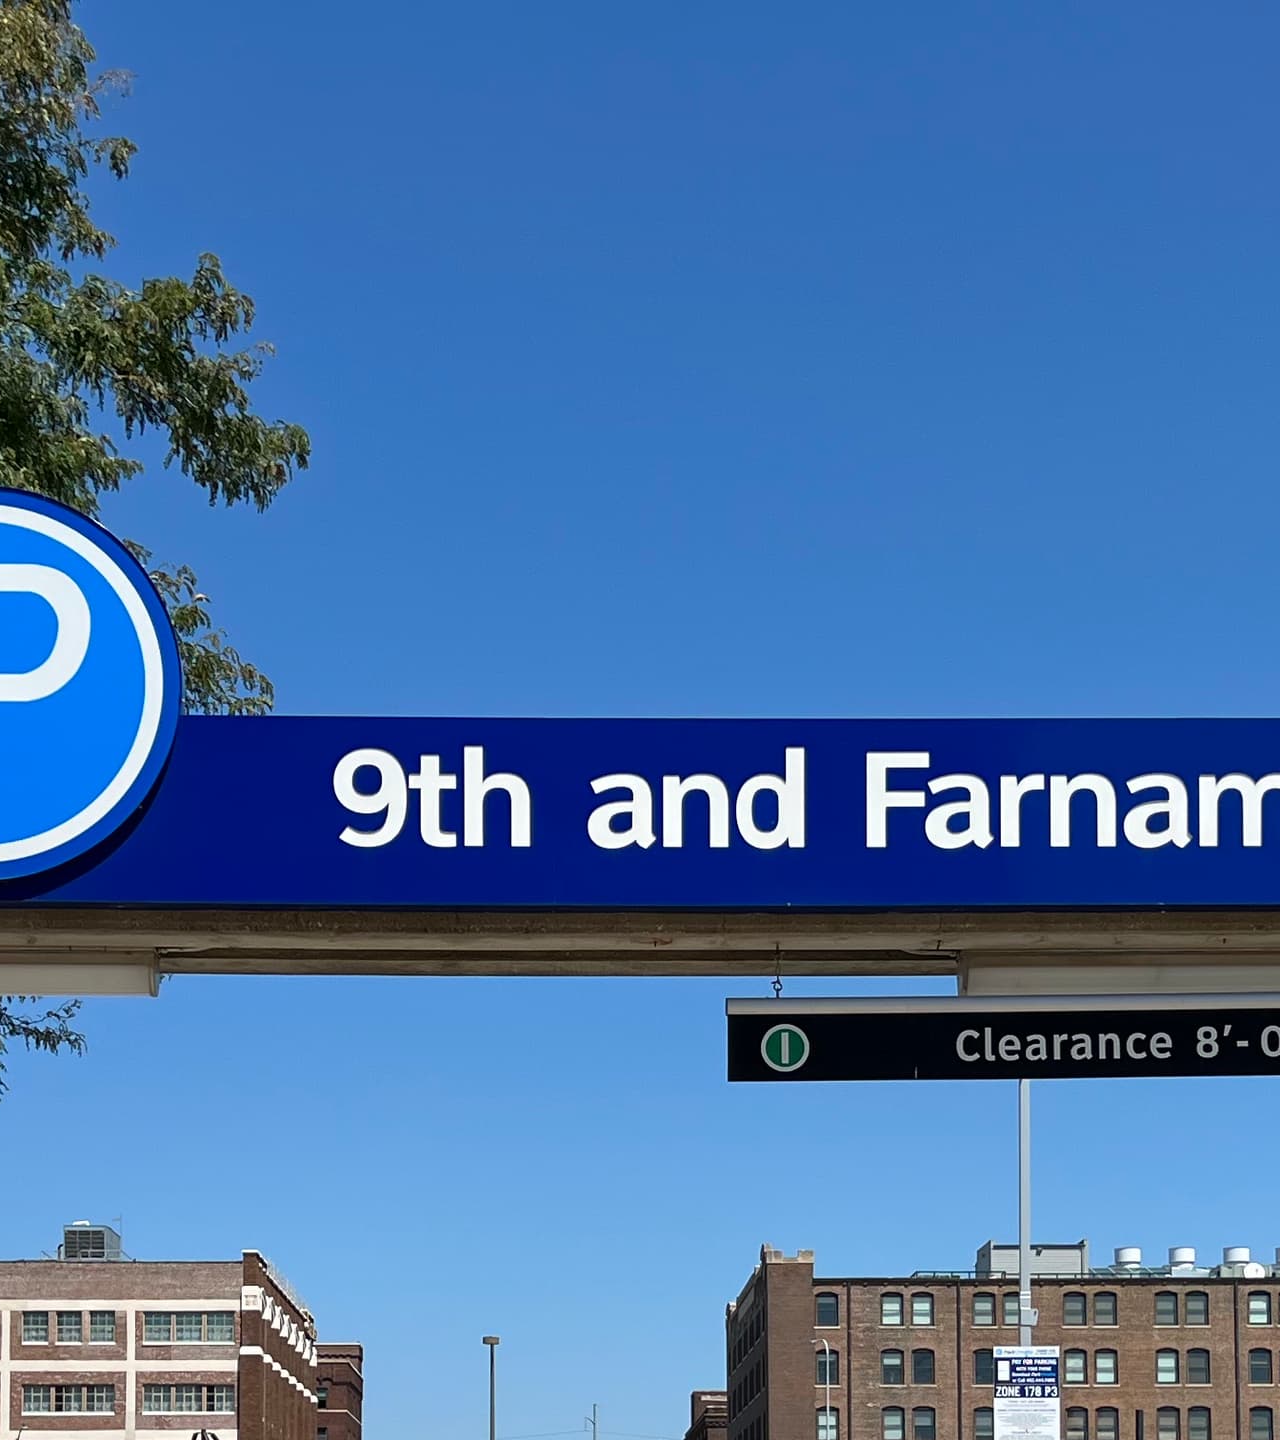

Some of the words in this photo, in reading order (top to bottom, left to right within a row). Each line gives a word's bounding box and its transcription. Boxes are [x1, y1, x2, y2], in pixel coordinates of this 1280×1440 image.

[332, 745, 532, 849] 9th
[586, 747, 806, 850] and
[955, 1026, 1173, 1062] Clearance
[996, 1386, 1021, 1396] ZONE
[1024, 1386, 1042, 1396] 178
[1044, 1386, 1058, 1396] P3
